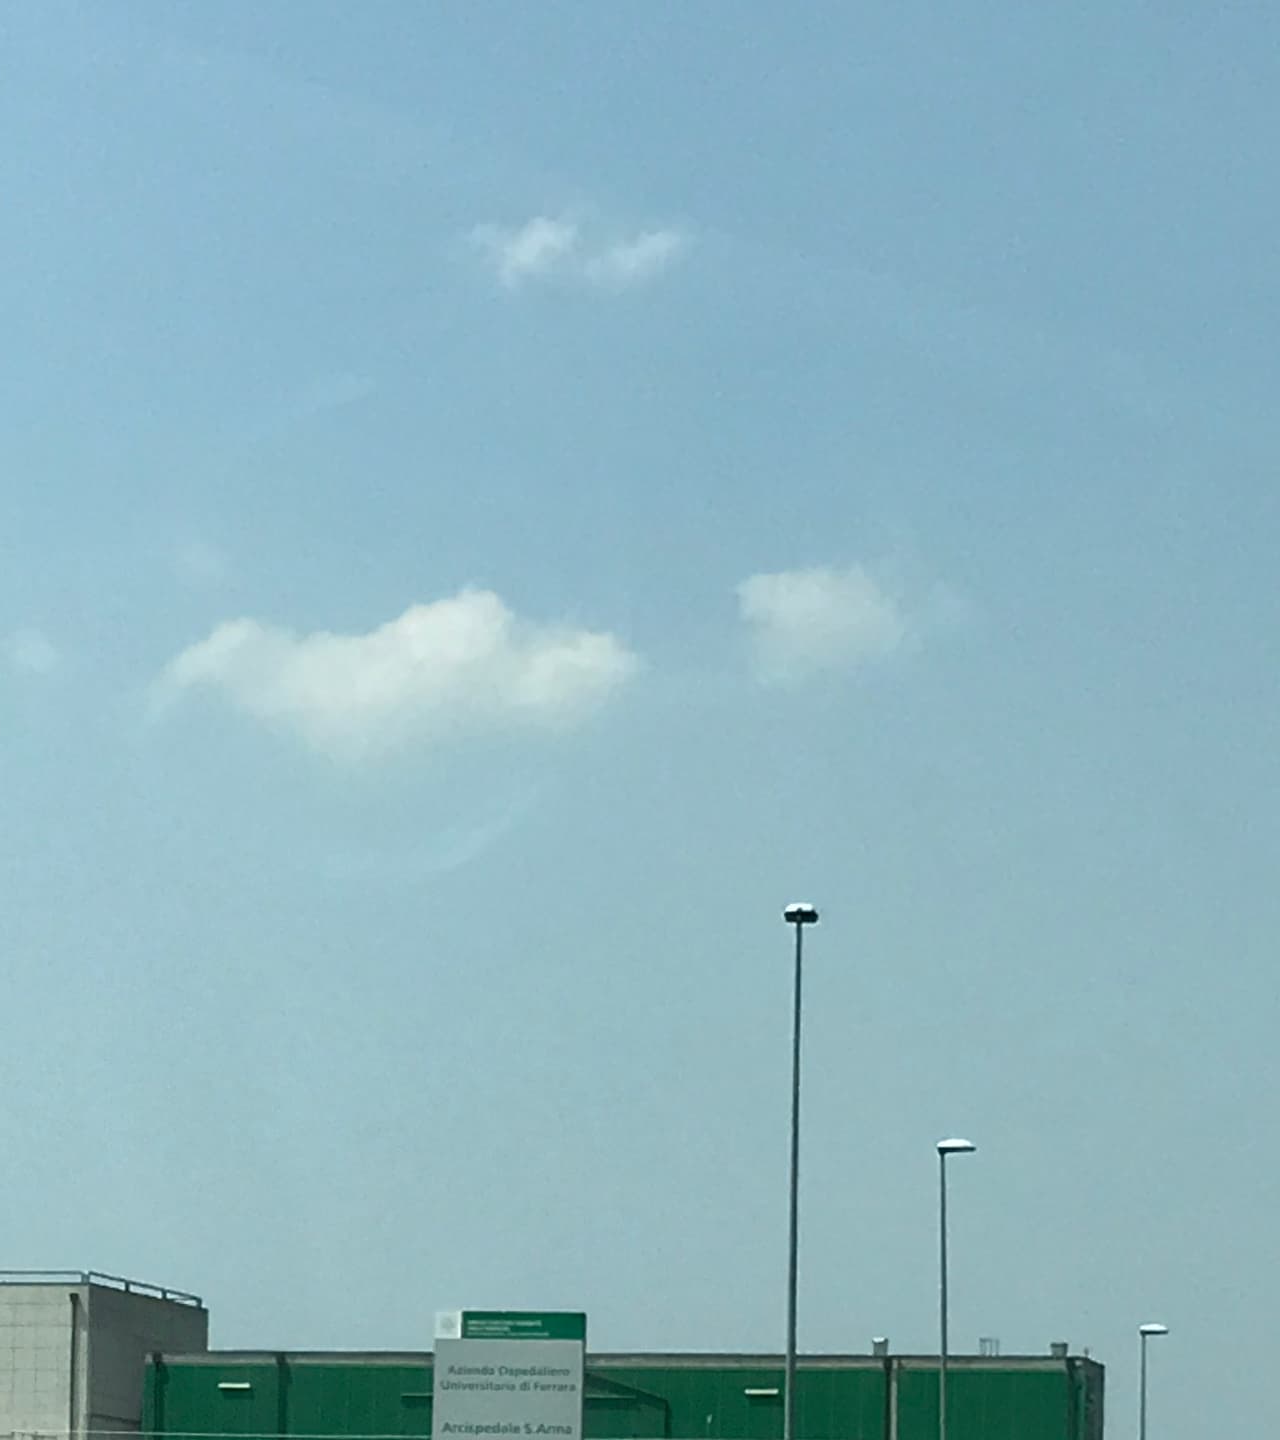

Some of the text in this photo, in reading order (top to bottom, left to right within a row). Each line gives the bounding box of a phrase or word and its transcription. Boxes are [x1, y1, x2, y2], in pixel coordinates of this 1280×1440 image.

[447, 1365, 570, 1378] Azienda Ospedaliero
[520, 1381, 531, 1391] di
[535, 1382, 576, 1392] Ferrara
[442, 1422, 521, 1435] Arcispedale
